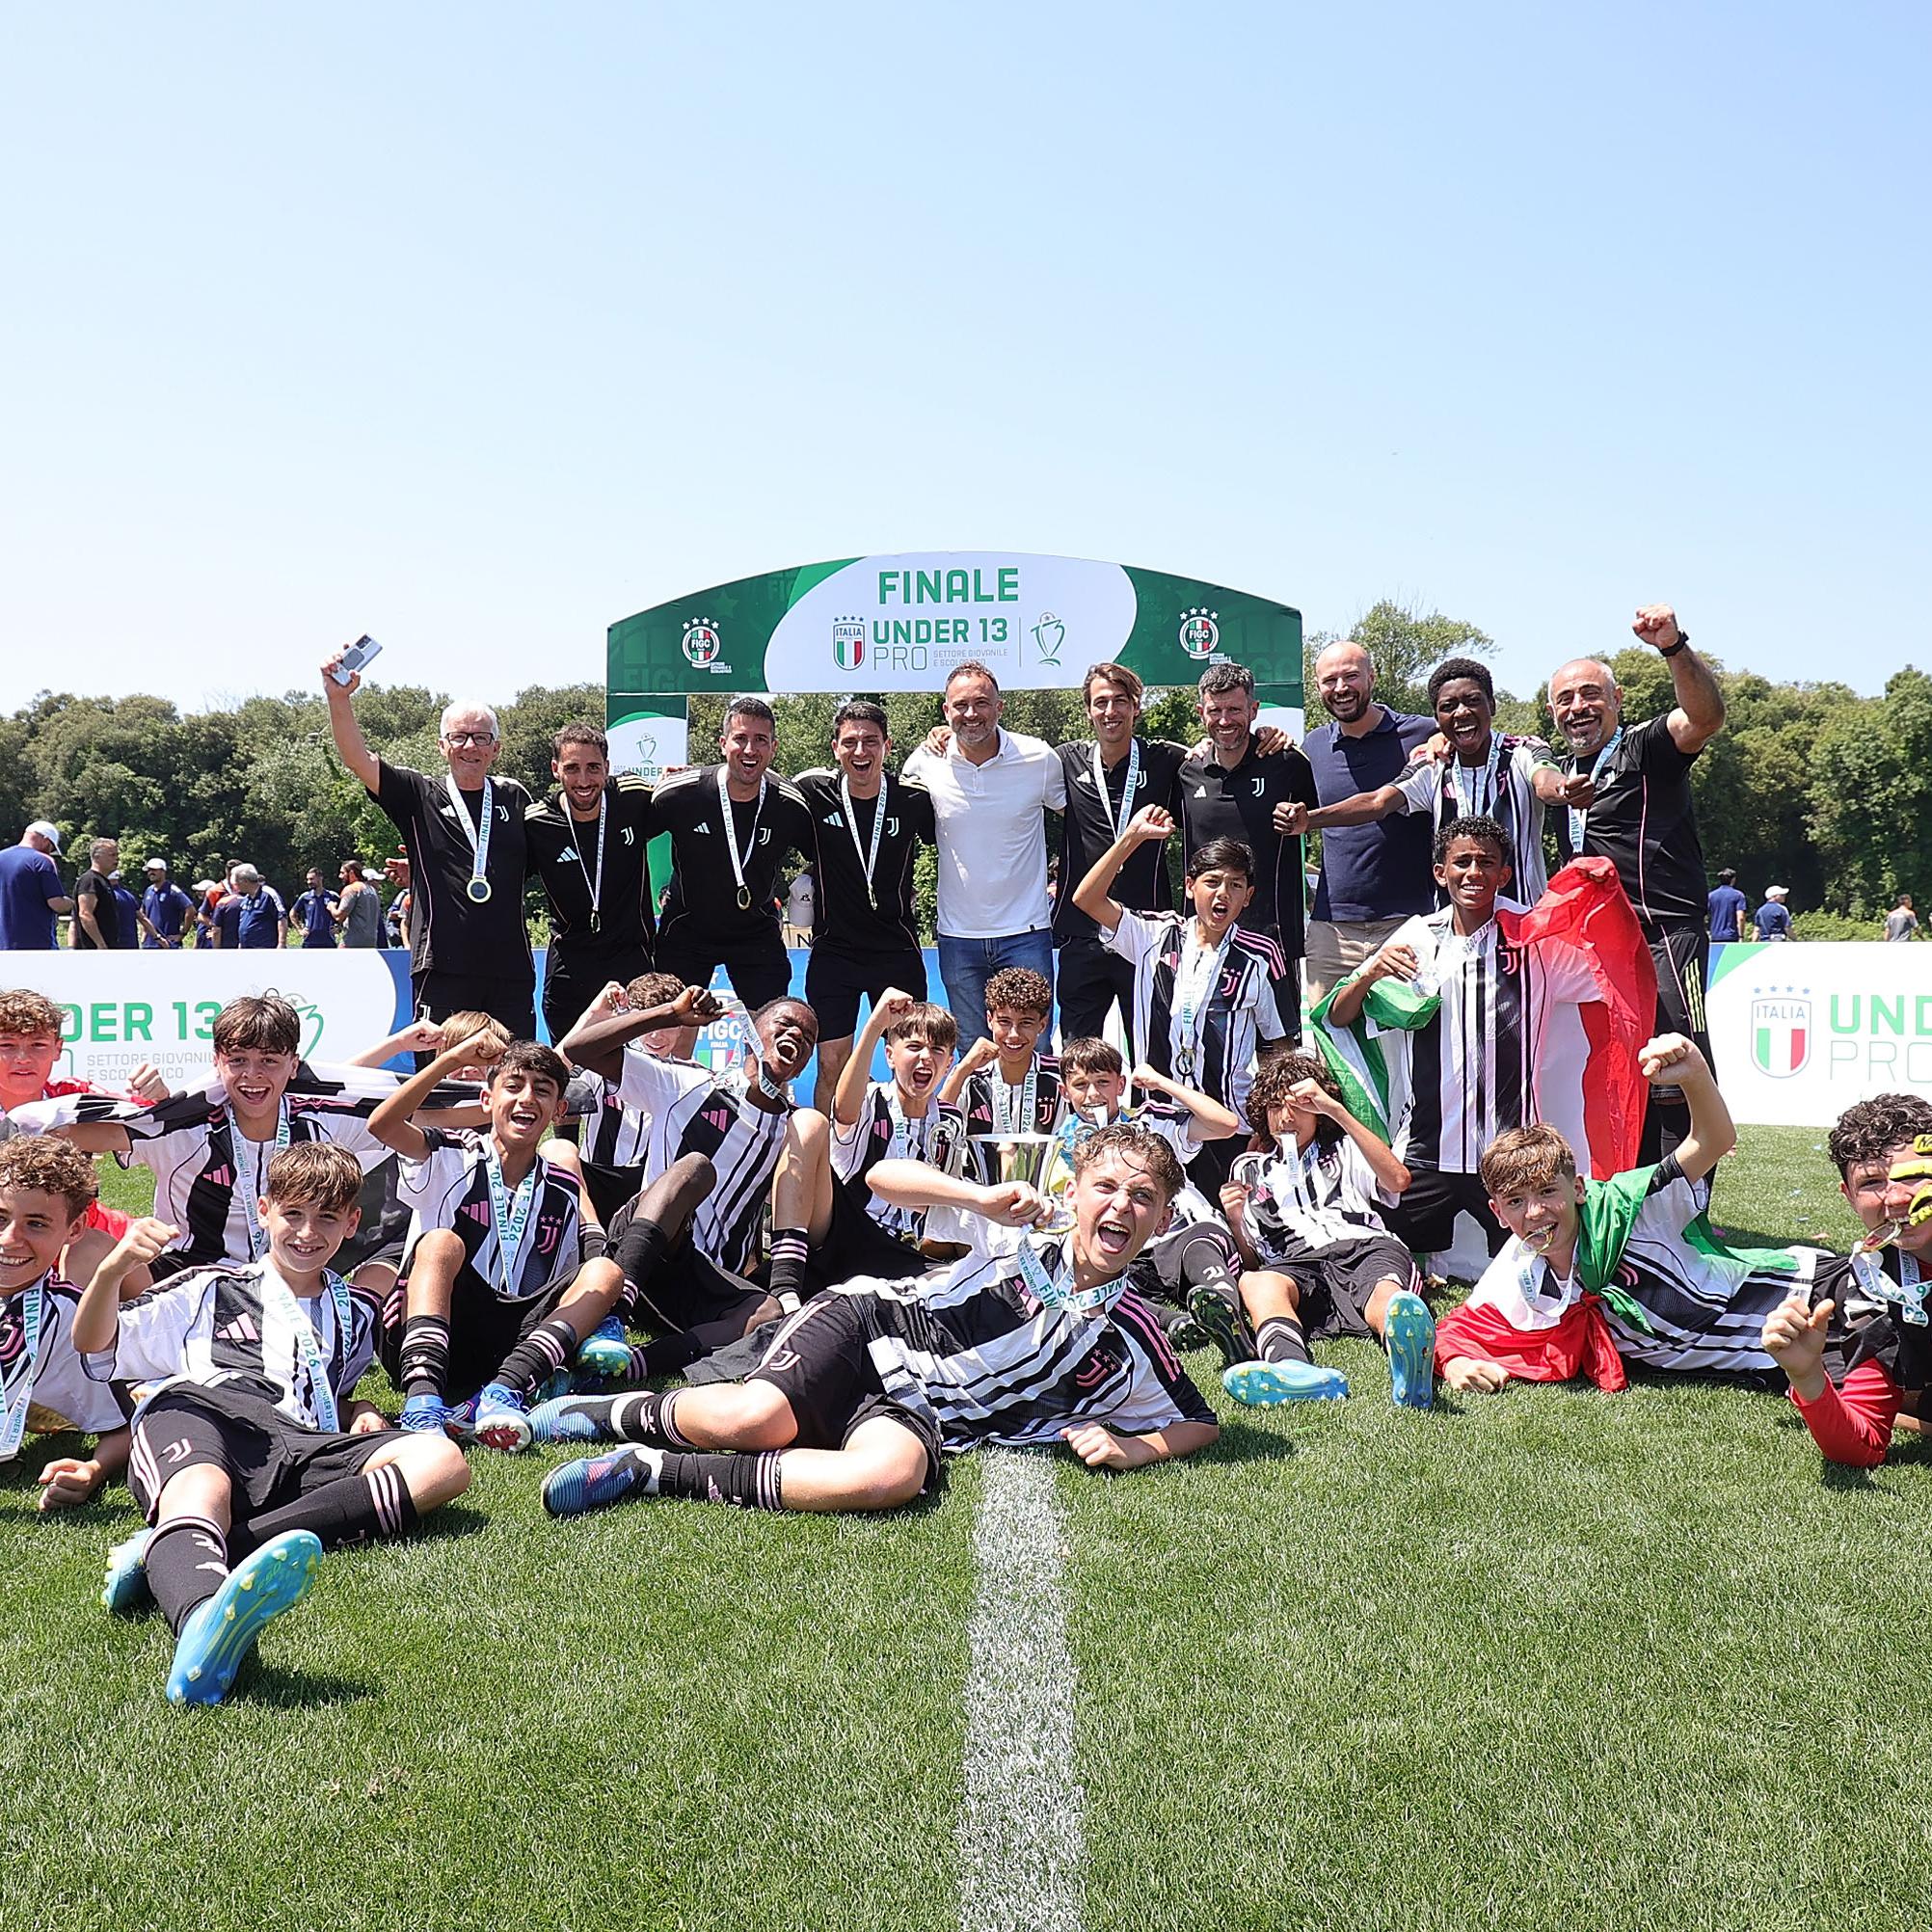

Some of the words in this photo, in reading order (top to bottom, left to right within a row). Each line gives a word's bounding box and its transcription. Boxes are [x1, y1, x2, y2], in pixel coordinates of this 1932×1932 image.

[878, 567, 1019, 604] FINALE
[691, 638, 711, 649] FIGC
[835, 627, 863, 637] ITALIA
[872, 618, 970, 645] UNDER
[979, 617, 1008, 643] 13
[1188, 629, 1210, 640] FIGC
[872, 646, 928, 672] PRO
[933, 649, 967, 658] SETTORE
[968, 648, 1008, 657] GIOVANILE
[878, 786, 887, 808] 2026
[1124, 772, 1136, 803] FINALE
[483, 791, 492, 812] 2026
[480, 814, 491, 843] FINALE
[873, 811, 884, 841] FINALE
[56, 1001, 153, 1043] DER
[173, 1001, 223, 1041] 13
[1756, 1005, 1806, 1020] ITALIA
[1830, 994, 1932, 1035] UND
[696, 1020, 742, 1040] FIGC
[87, 1054, 148, 1066] SETTORE
[151, 1051, 214, 1065] GIOVANIL
[1024, 1070, 1034, 1104] FINALE
[999, 1101, 1012, 1135] FINALE
[1021, 1107, 1033, 1134] 2026
[495, 1194, 509, 1241] FINALE
[508, 1207, 527, 1242] 2026
[331, 1275, 350, 1308] 2026
[1091, 1276, 1125, 1303] NALE
[25, 1288, 40, 1344] FINALE
[296, 1329, 321, 1368] 2026
[320, 1385, 333, 1410] UNDER
[13, 1409, 23, 1434] UNDER
